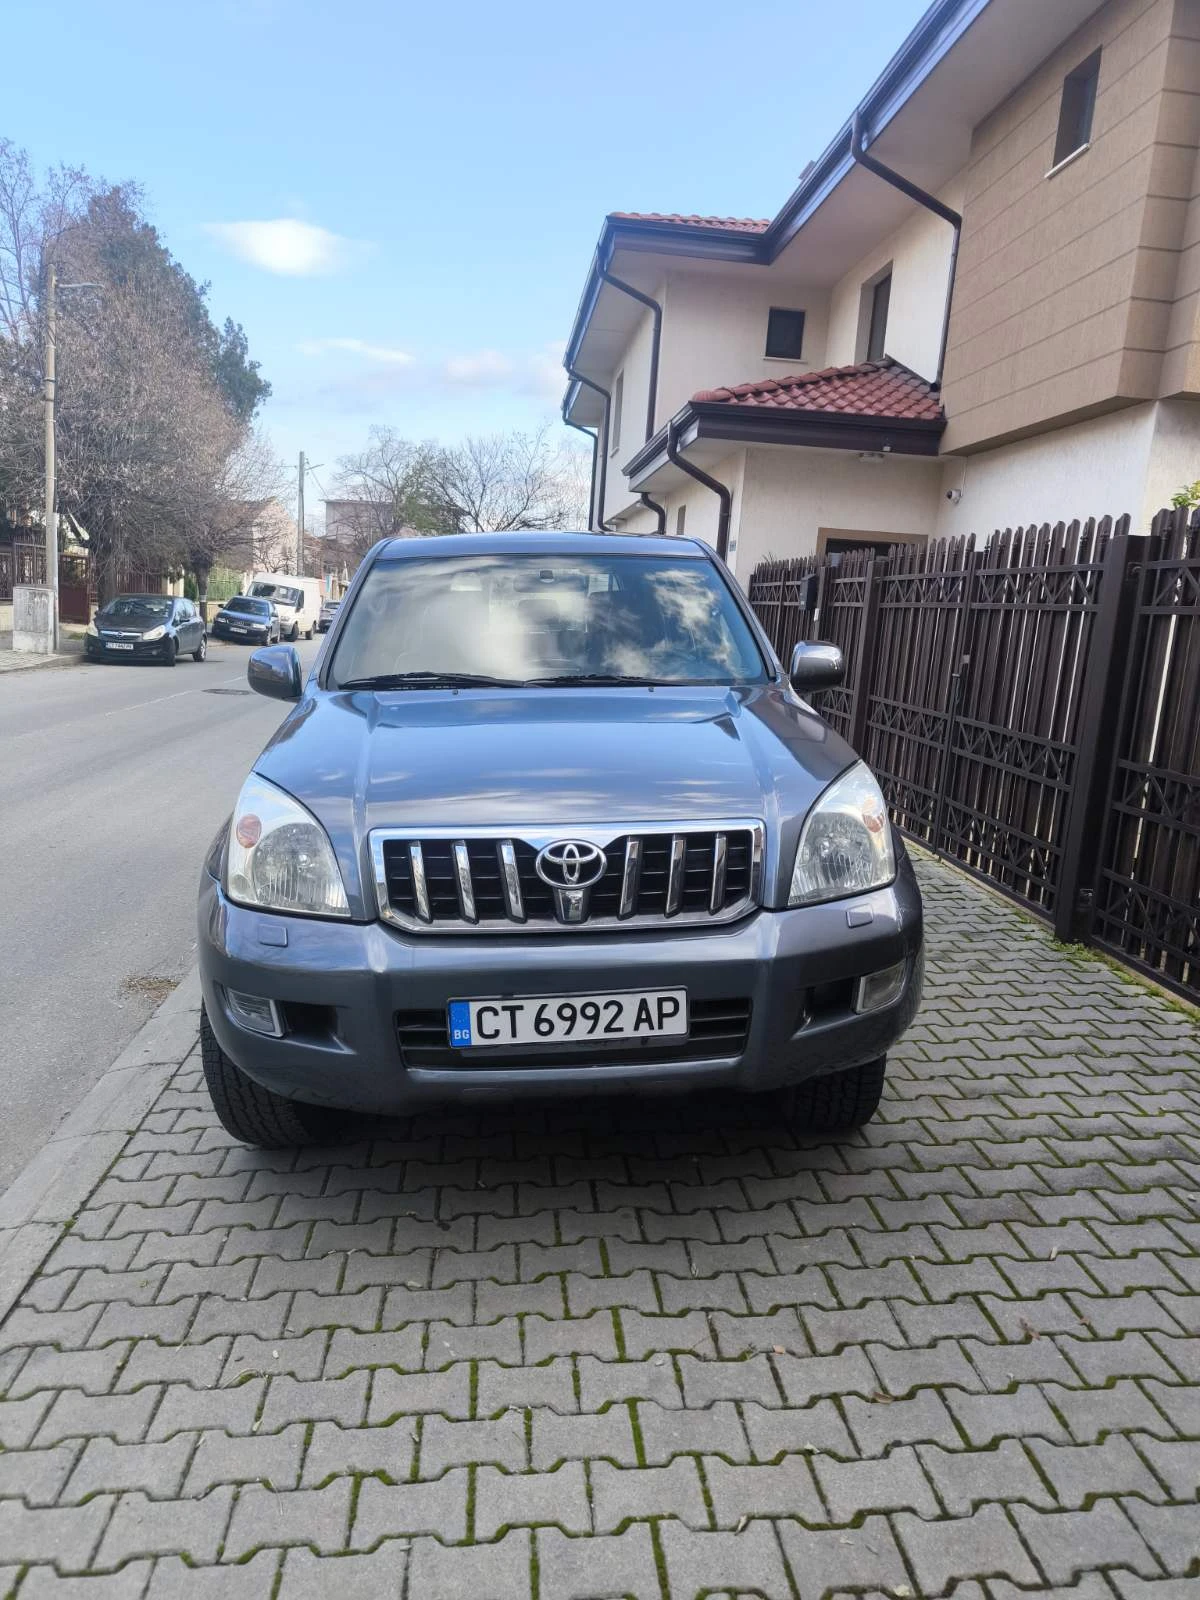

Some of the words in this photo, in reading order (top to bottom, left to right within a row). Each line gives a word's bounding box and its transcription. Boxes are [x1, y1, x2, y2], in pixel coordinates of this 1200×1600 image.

[476, 1005, 524, 1039] CT
[534, 1000, 624, 1036] 6992
[633, 996, 680, 1031] AP
[453, 1030, 470, 1040] BG
